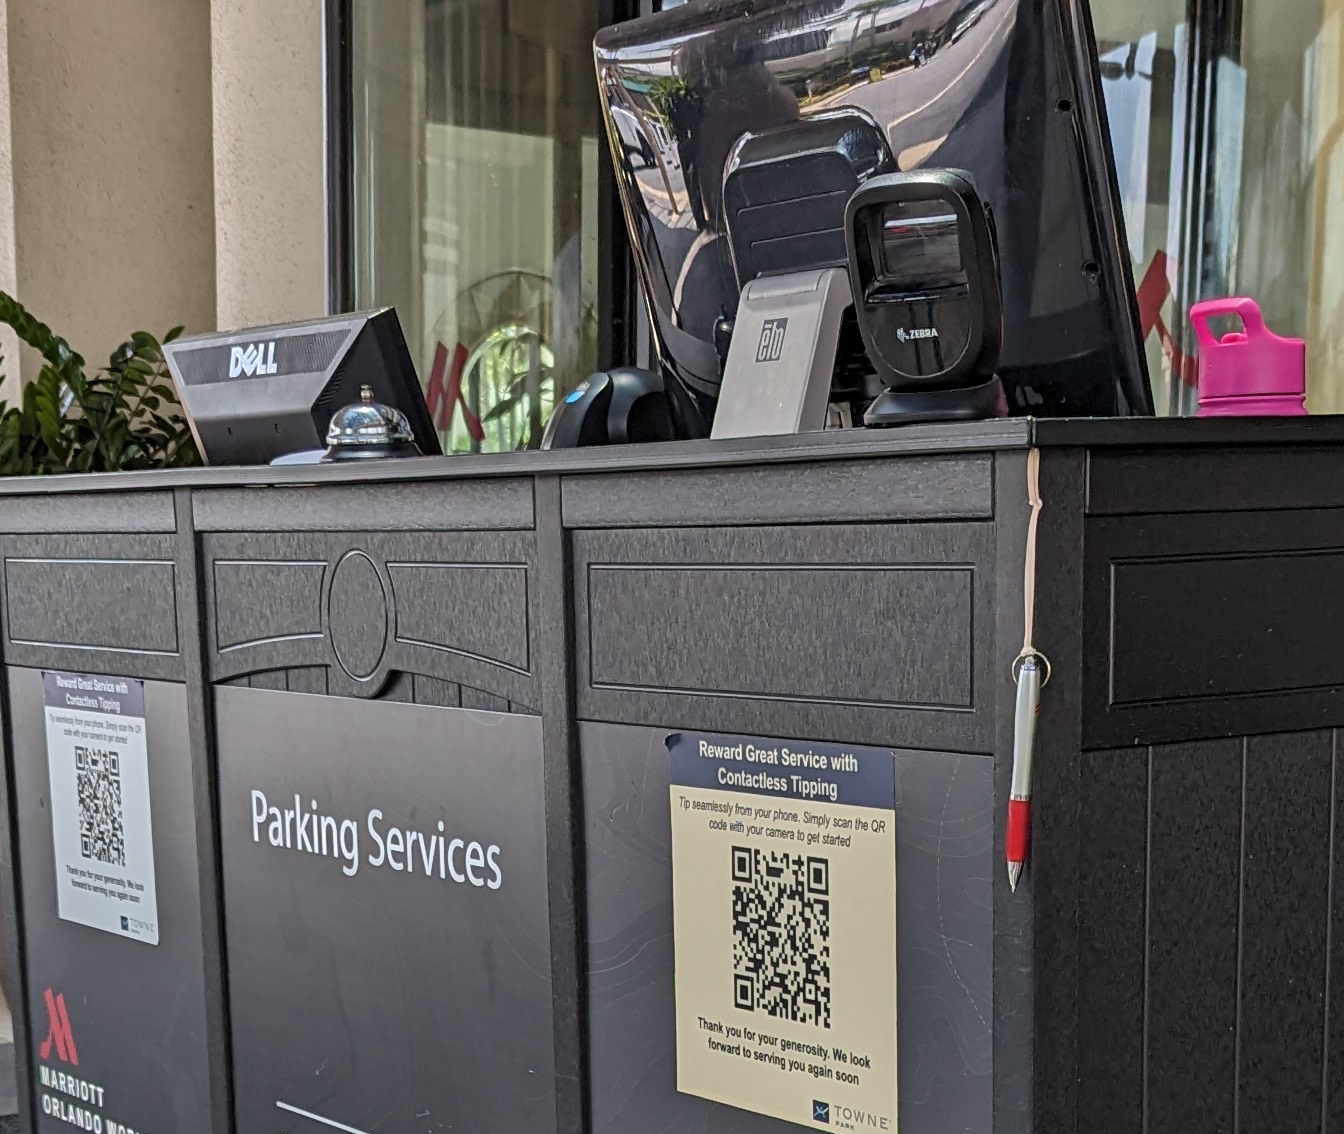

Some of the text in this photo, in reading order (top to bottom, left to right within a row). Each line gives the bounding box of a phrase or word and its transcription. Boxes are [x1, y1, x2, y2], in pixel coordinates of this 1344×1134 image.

[909, 328, 938, 340] ZEBRA
[229, 342, 277, 378] DELL
[78, 678, 93, 691] Great
[94, 679, 114, 692] Service
[98, 697, 120, 713] Tipping
[699, 740, 858, 772] Reward Great Service with
[718, 767, 838, 800] Contactless Tipping
[679, 796, 886, 833] Tip seamlessly from your phone. Simply scan the QR
[251, 789, 502, 889] Parking Services
[708, 818, 851, 848] code with your camera to get started
[697, 1016, 871, 1069] Thank you for your generosity. We look
[708, 1037, 859, 1086] forward to serving you again soon
[40, 1065, 104, 1107] MARRIOTT
[834, 1104, 889, 1130] TOWNE
[835, 1120, 855, 1131] PARK
